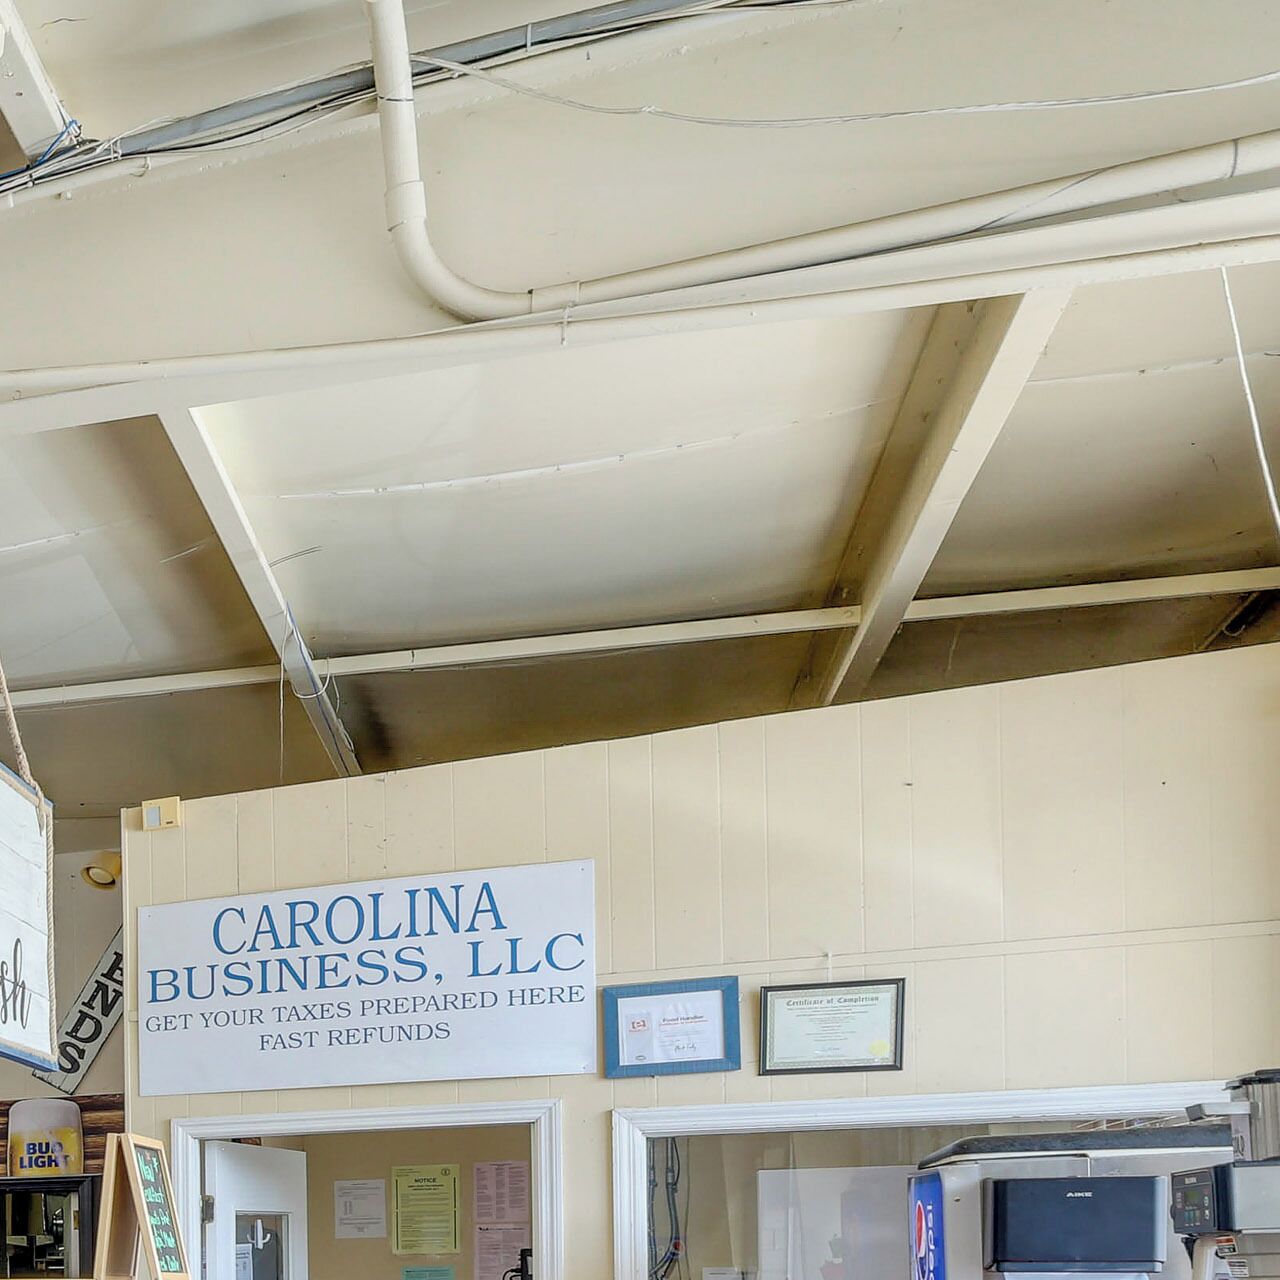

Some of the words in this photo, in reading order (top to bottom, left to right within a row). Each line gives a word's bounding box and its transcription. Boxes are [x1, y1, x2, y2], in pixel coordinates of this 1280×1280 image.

[213, 881, 508, 955] CAROLINA
[148, 945, 443, 1004] BUSINESS,
[467, 932, 586, 978] LLC
[146, 1014, 192, 1032] GET
[200, 1008, 264, 1029] YOUR
[272, 1002, 351, 1024] TAXES
[361, 992, 497, 1017] PREPARED
[508, 985, 585, 1004] HERE
[260, 1032, 319, 1051] FAST
[328, 1022, 451, 1047] REFUNDS
[19, 1155, 70, 1169] LIGHT
[26, 1143, 64, 1155] BUD
